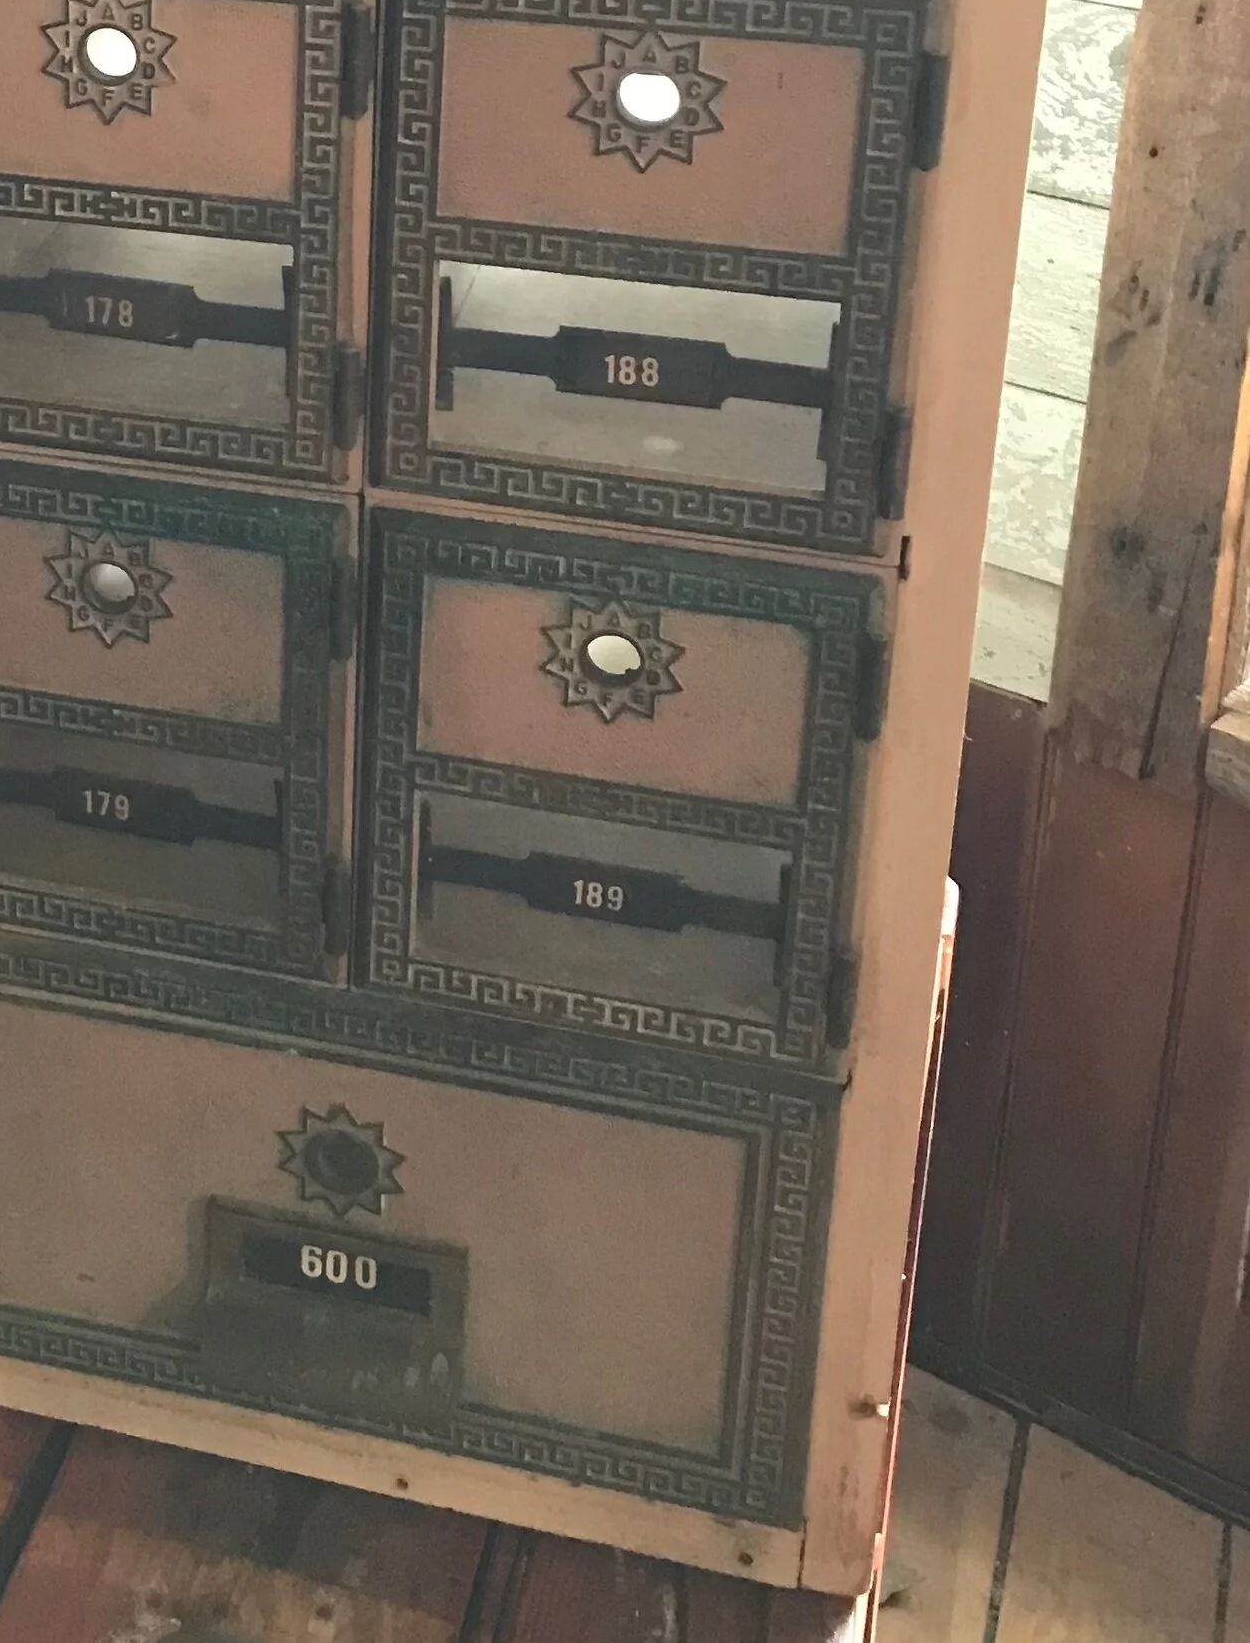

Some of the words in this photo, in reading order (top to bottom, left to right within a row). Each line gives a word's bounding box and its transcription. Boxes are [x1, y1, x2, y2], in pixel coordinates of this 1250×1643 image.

[85, 296, 133, 327] 178
[604, 355, 659, 386] 188
[83, 790, 130, 820] 179
[574, 879, 623, 910] 189
[301, 1245, 377, 1289] 600
